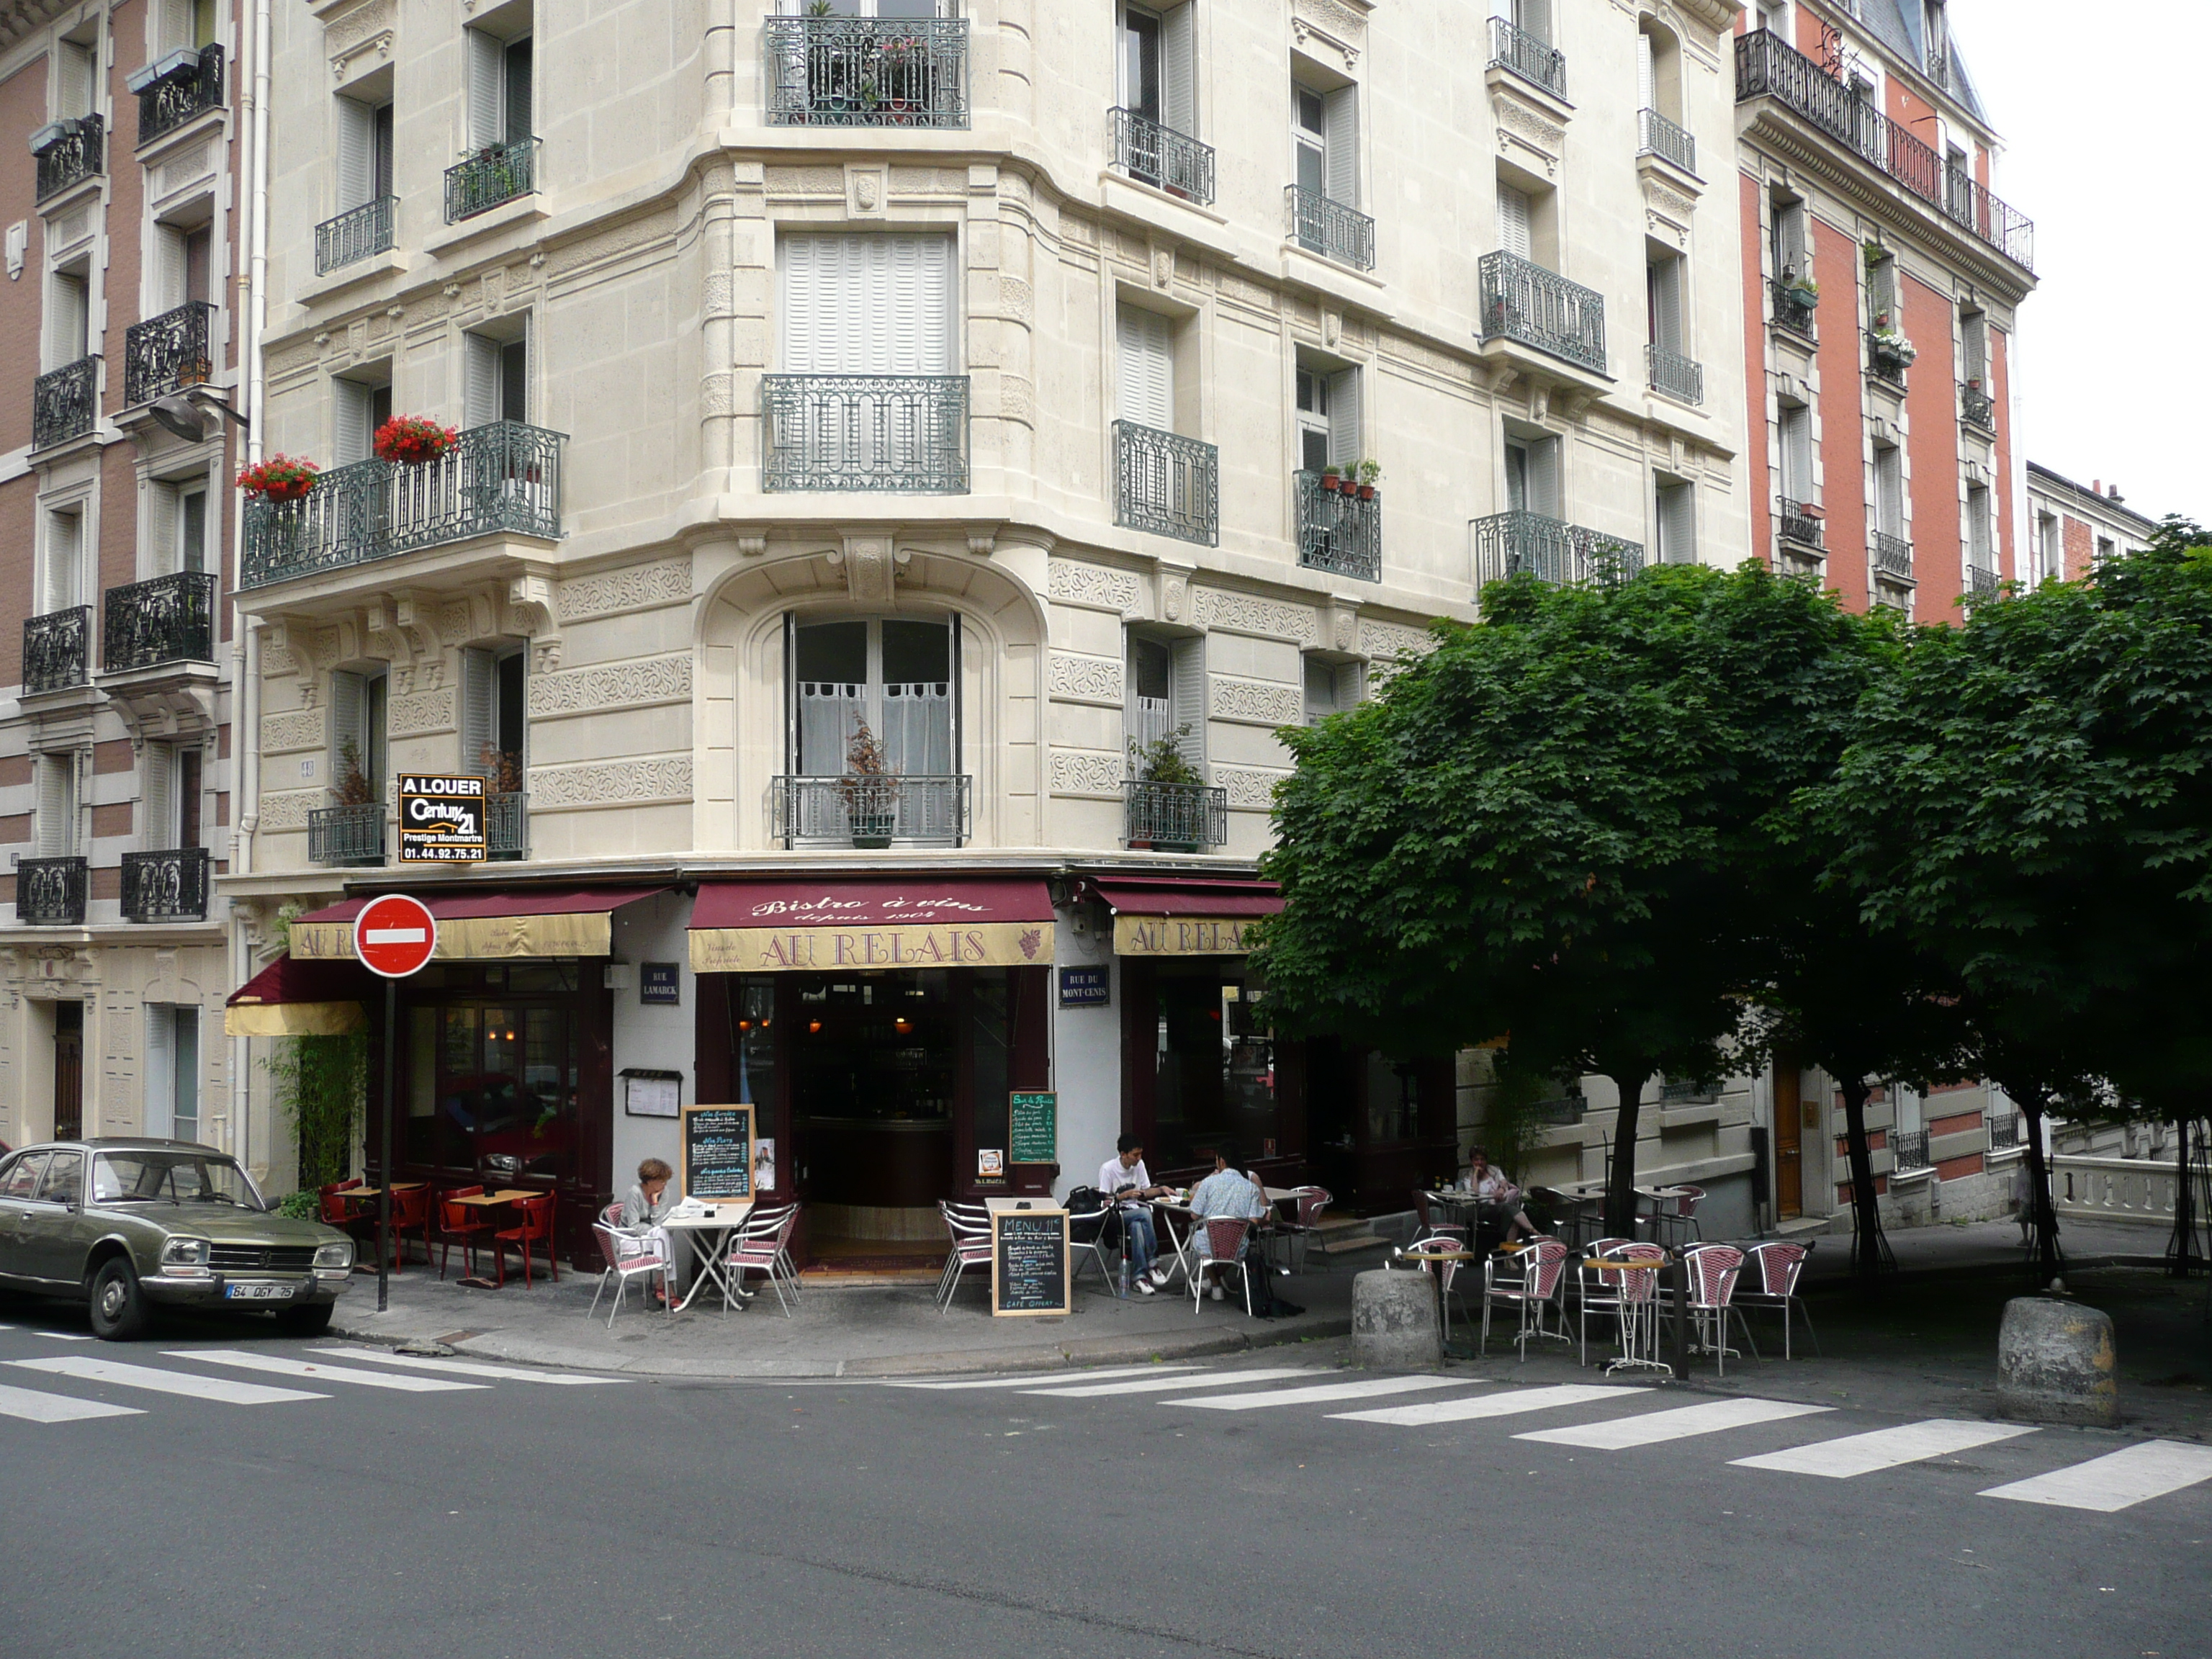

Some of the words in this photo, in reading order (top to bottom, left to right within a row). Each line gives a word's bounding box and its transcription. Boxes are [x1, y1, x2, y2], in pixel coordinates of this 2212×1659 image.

[302, 762, 313, 776] 48
[403, 778, 417, 793] A
[421, 778, 481, 794] LOUER
[410, 799, 464, 821] Century
[457, 814, 474, 834] 21
[404, 833, 436, 843] Prestige
[405, 848, 482, 859] 01.44.92.75.21
[752, 896, 869, 916] Bistro
[883, 896, 914, 908] à
[917, 896, 993, 912] vins
[795, 913, 874, 922] depuis
[885, 911, 935, 920] 1904
[300, 929, 327, 956] AU
[1131, 921, 1168, 951] AU
[760, 935, 817, 966] AU
[832, 930, 985, 965] RELAIS
[1070, 976, 1085, 984] RUE
[1088, 975, 1098, 984] DU
[644, 986, 677, 994] LAMARCK
[1063, 987, 1106, 998] MONT-CENIS
[1003, 1218, 1042, 1232] MENU
[233, 1287, 246, 1297] 64
[281, 1287, 292, 1297] 75
